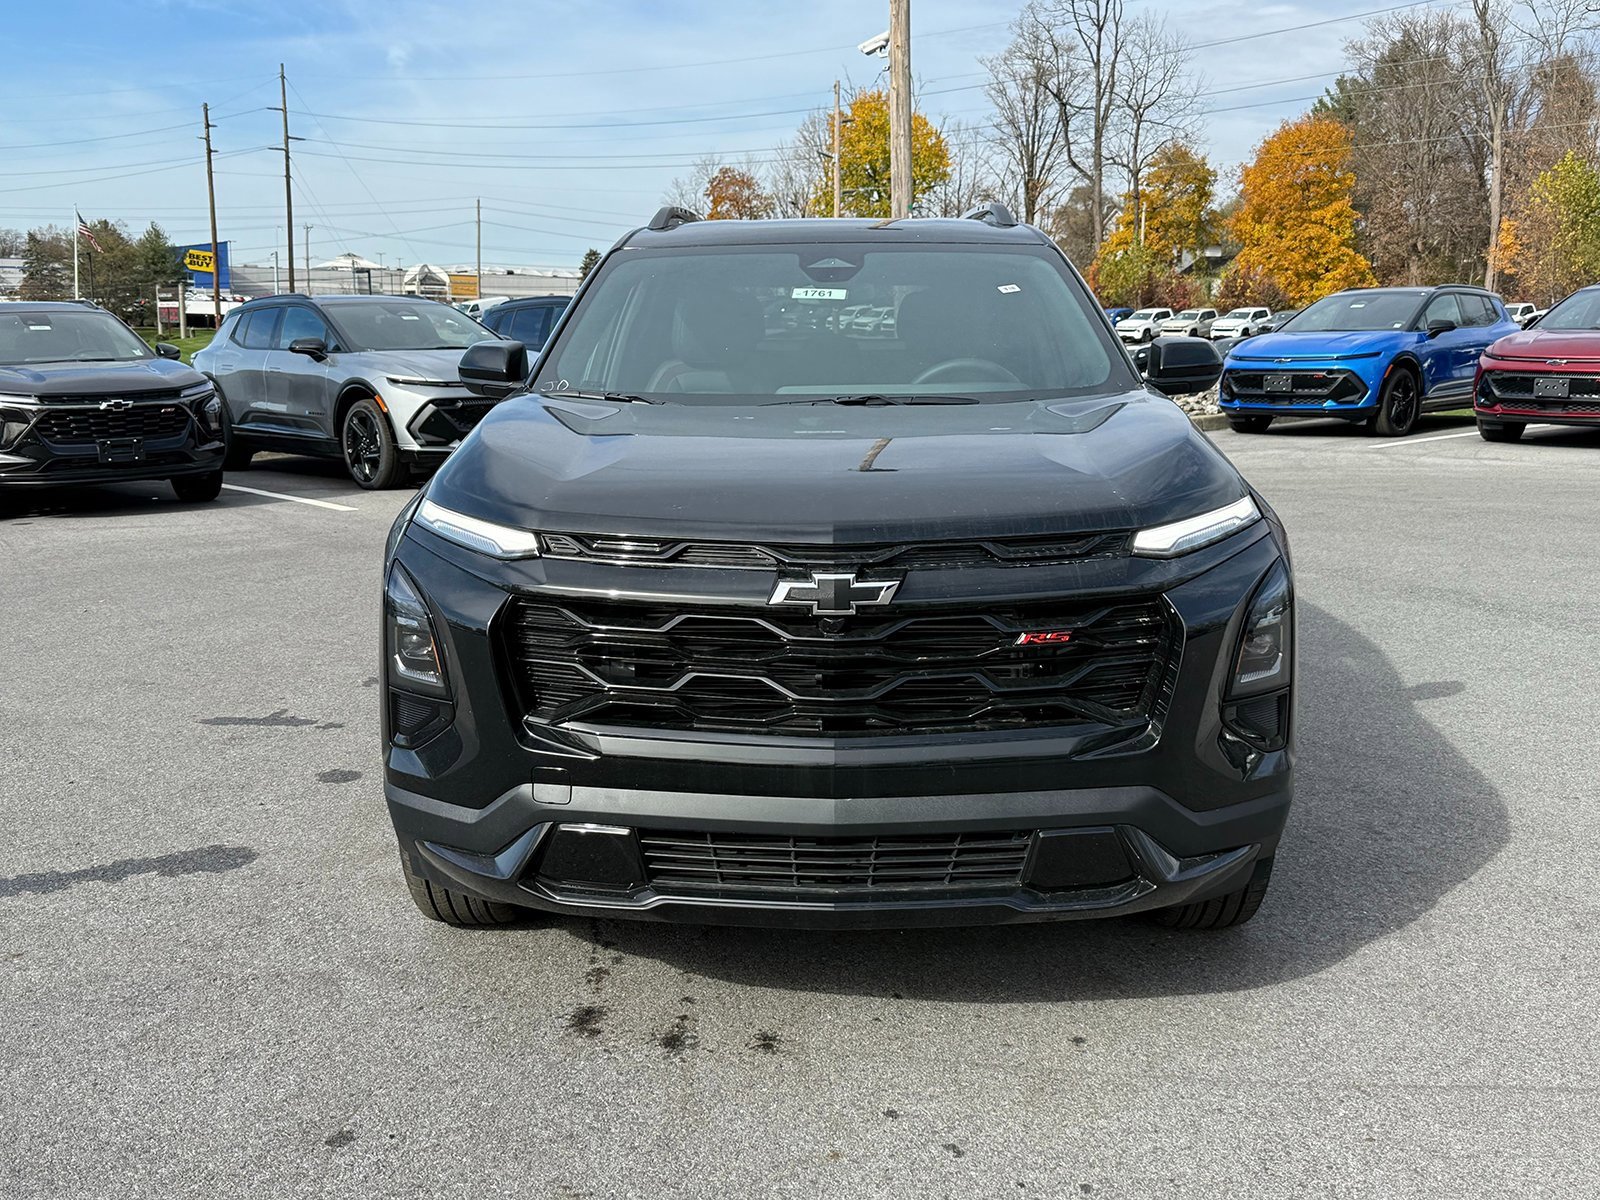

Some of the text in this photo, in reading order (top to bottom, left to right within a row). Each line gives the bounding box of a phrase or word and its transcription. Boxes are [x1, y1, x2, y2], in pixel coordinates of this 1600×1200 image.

[188, 252, 212, 262] BEST
[189, 260, 211, 268] BUY
[802, 289, 833, 298] 1761
[1015, 631, 1071, 645] RS
